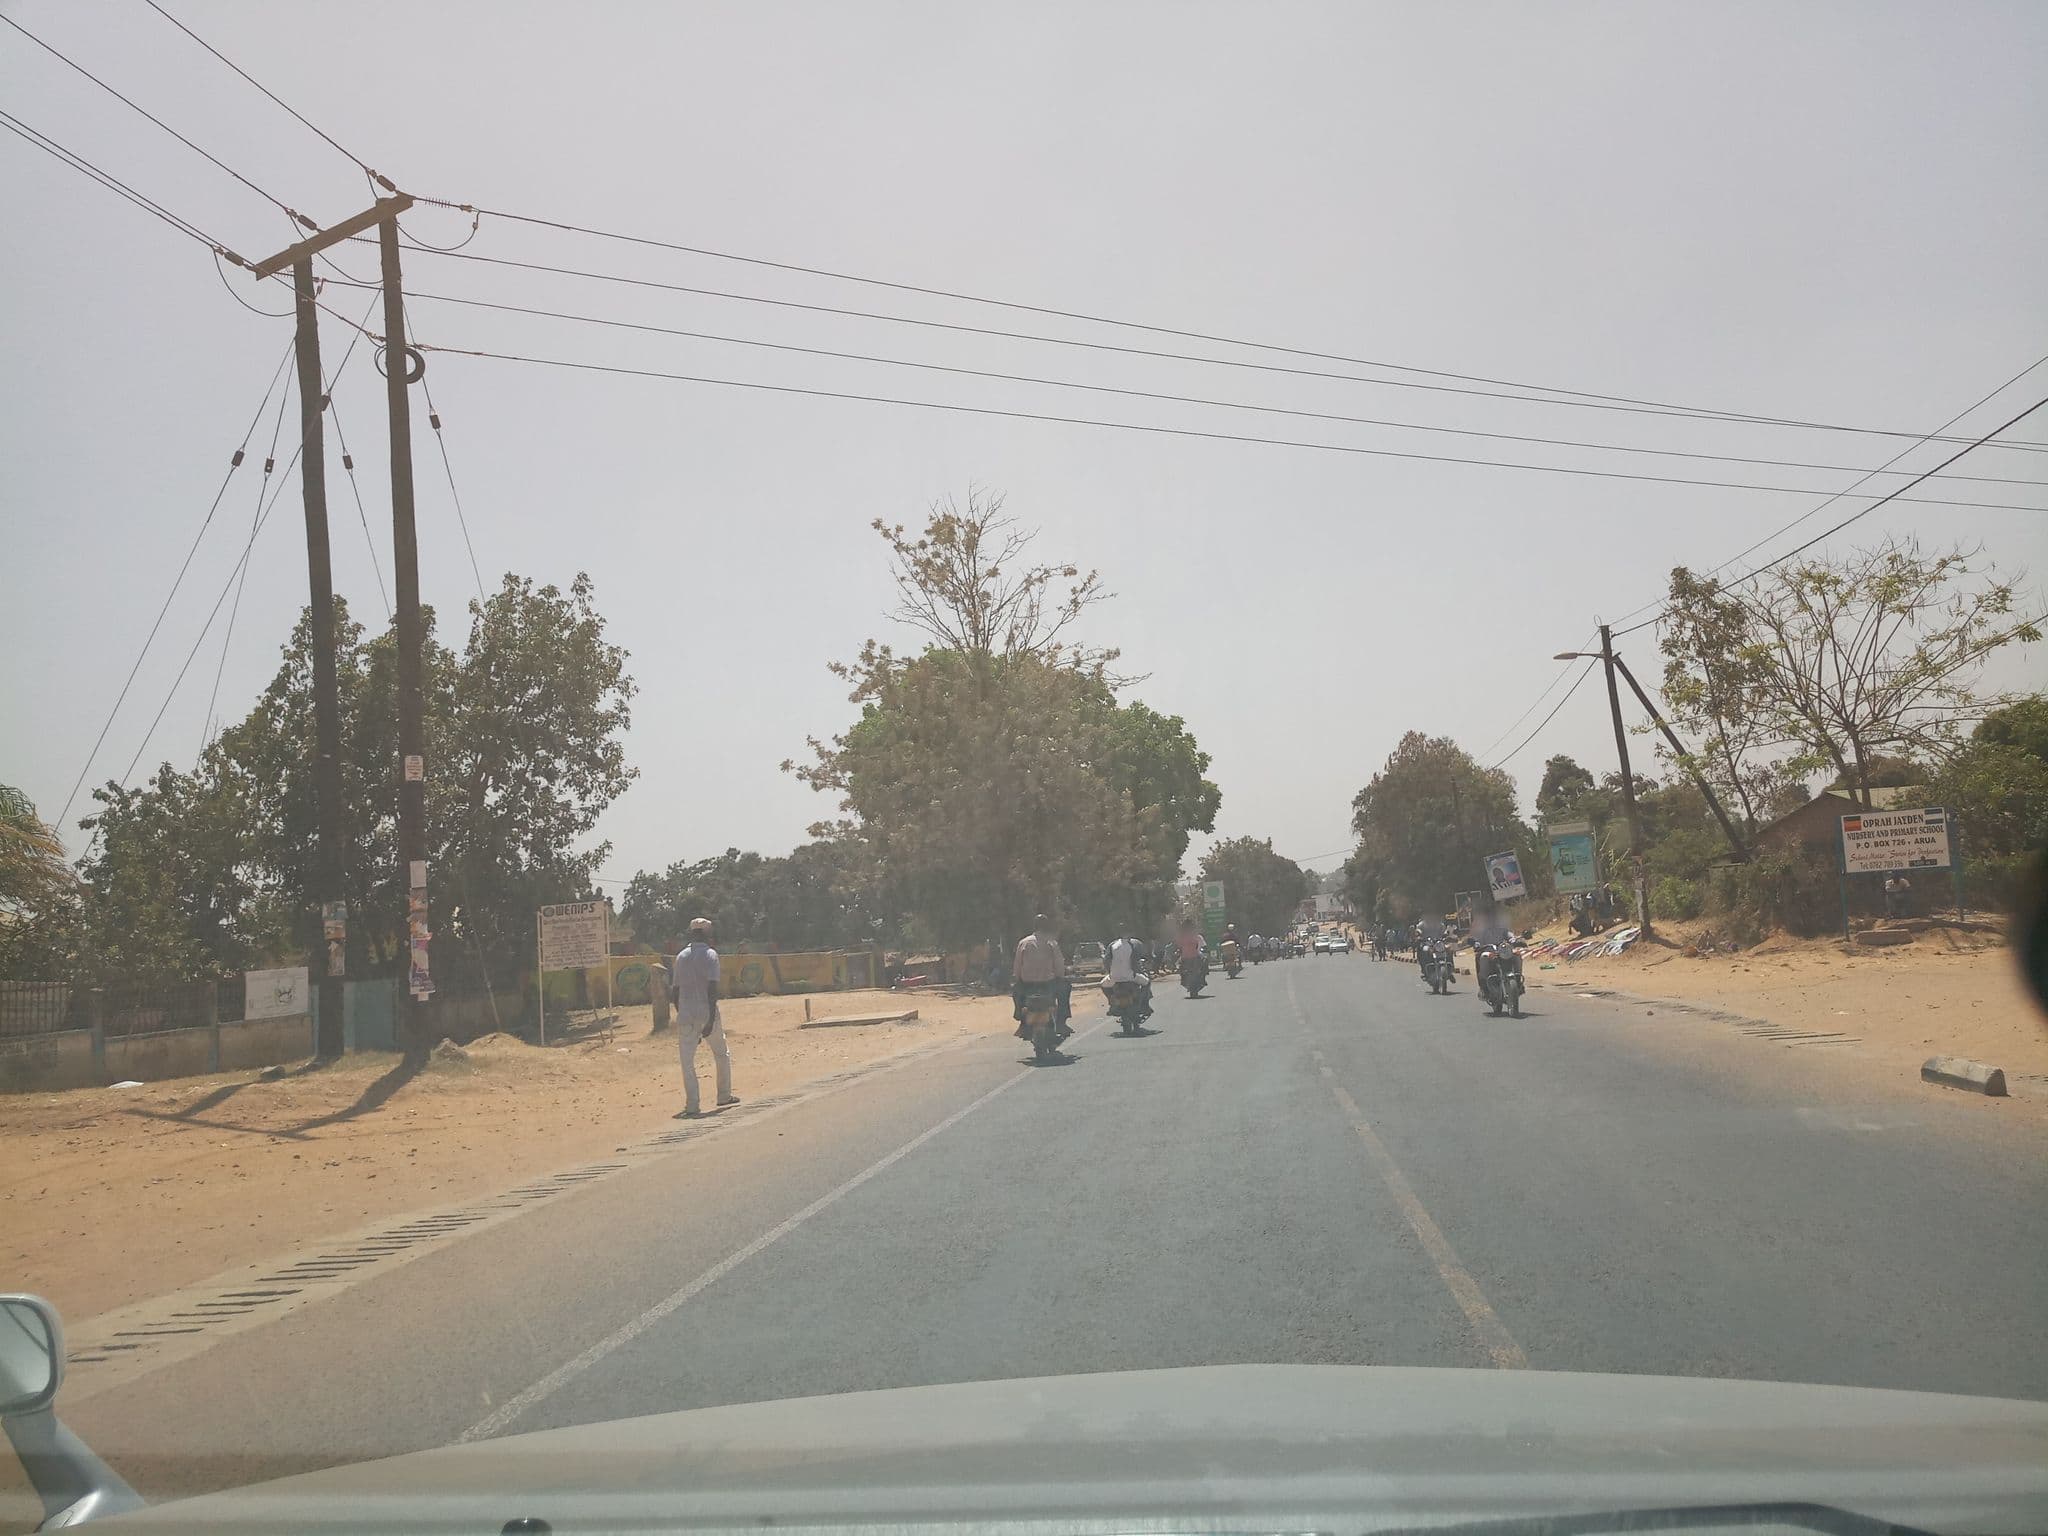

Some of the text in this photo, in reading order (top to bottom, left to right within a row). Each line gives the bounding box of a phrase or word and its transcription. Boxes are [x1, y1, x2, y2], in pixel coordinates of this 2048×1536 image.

[1863, 814, 1924, 828] OPRAH JAYDEN
[1847, 824, 1945, 841] NURSERY AND PRIMARY SCHOOL
[1874, 839, 1890, 847] BOX
